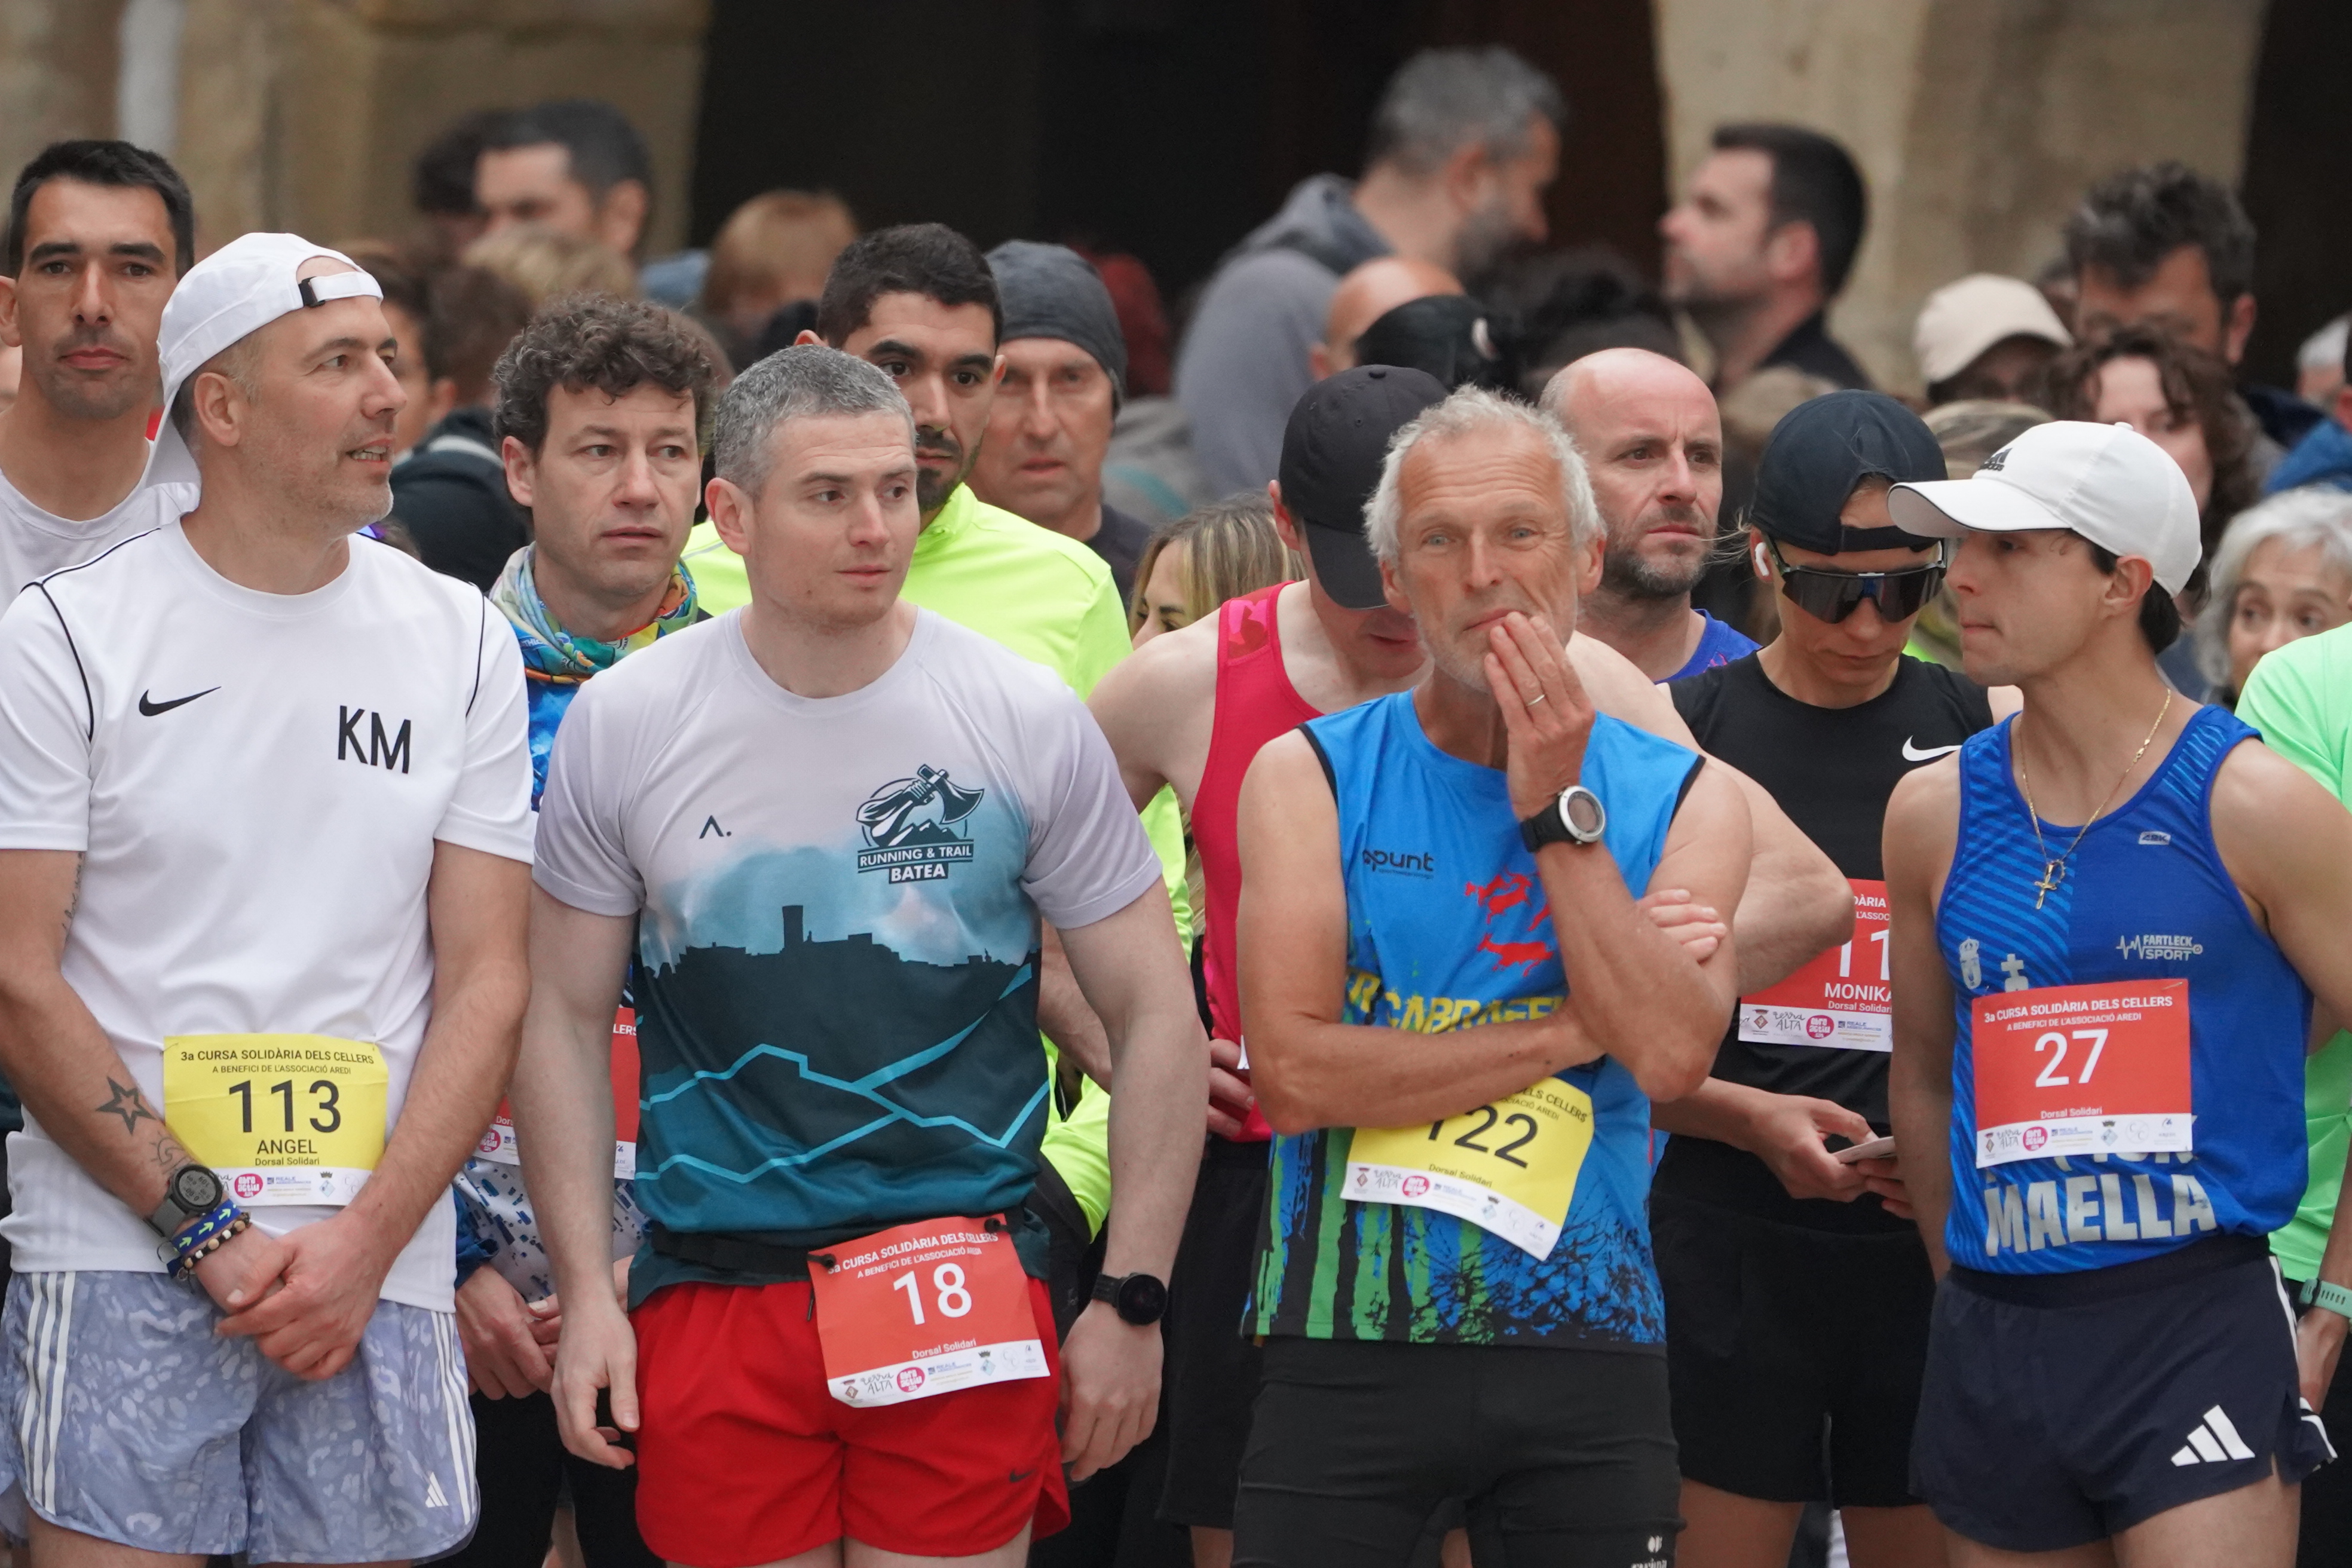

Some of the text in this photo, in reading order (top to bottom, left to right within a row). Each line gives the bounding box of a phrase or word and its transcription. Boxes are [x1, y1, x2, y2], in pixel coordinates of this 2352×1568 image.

[338, 705, 411, 774] KM
[860, 846, 972, 866] RUNNING & TRAIL
[891, 863, 945, 882] BATEA
[2143, 935, 2192, 946] FARTLECK
[2145, 949, 2191, 961] SPORT
[1828, 1000, 1857, 1011] Dorsal
[1984, 996, 2173, 1022] 3a CURSA SOLIDÀRIA DELS CELLERS
[613, 1024, 637, 1036] LERS
[1775, 1020, 1802, 1031] ALTA
[2013, 1019, 2047, 1030] BENEFICI
[2117, 1013, 2141, 1022] AREDI
[181, 1047, 374, 1064] 3a CURSA SOLIDÀRIA DELS CELLERS
[2034, 1028, 2108, 1088] 27
[274, 1064, 327, 1074] L'ASSOCIACIÓ
[330, 1066, 351, 1074] AREDI
[229, 1079, 341, 1134] 113
[1536, 1105, 1560, 1120] AREDI
[1546, 1093, 1588, 1123] CELLERS
[2041, 1106, 2102, 1119] Dorsal Solidari
[257, 1139, 318, 1154] ANGEL
[255, 1156, 320, 1166] Dorsal Solidari
[1428, 1163, 1492, 1188] Dorsal Solidari
[1984, 1174, 2217, 1257] MAELLA
[843, 1252, 879, 1270] CURSA
[881, 1235, 939, 1258] SOLIDÀRIA
[941, 1232, 965, 1245] DELS
[865, 1261, 899, 1277] BENEFICI
[901, 1257, 912, 1266] DE
[893, 1263, 972, 1325] 18
[912, 1339, 976, 1359] Dorsal Solidari
[868, 1380, 893, 1394] ALTA
